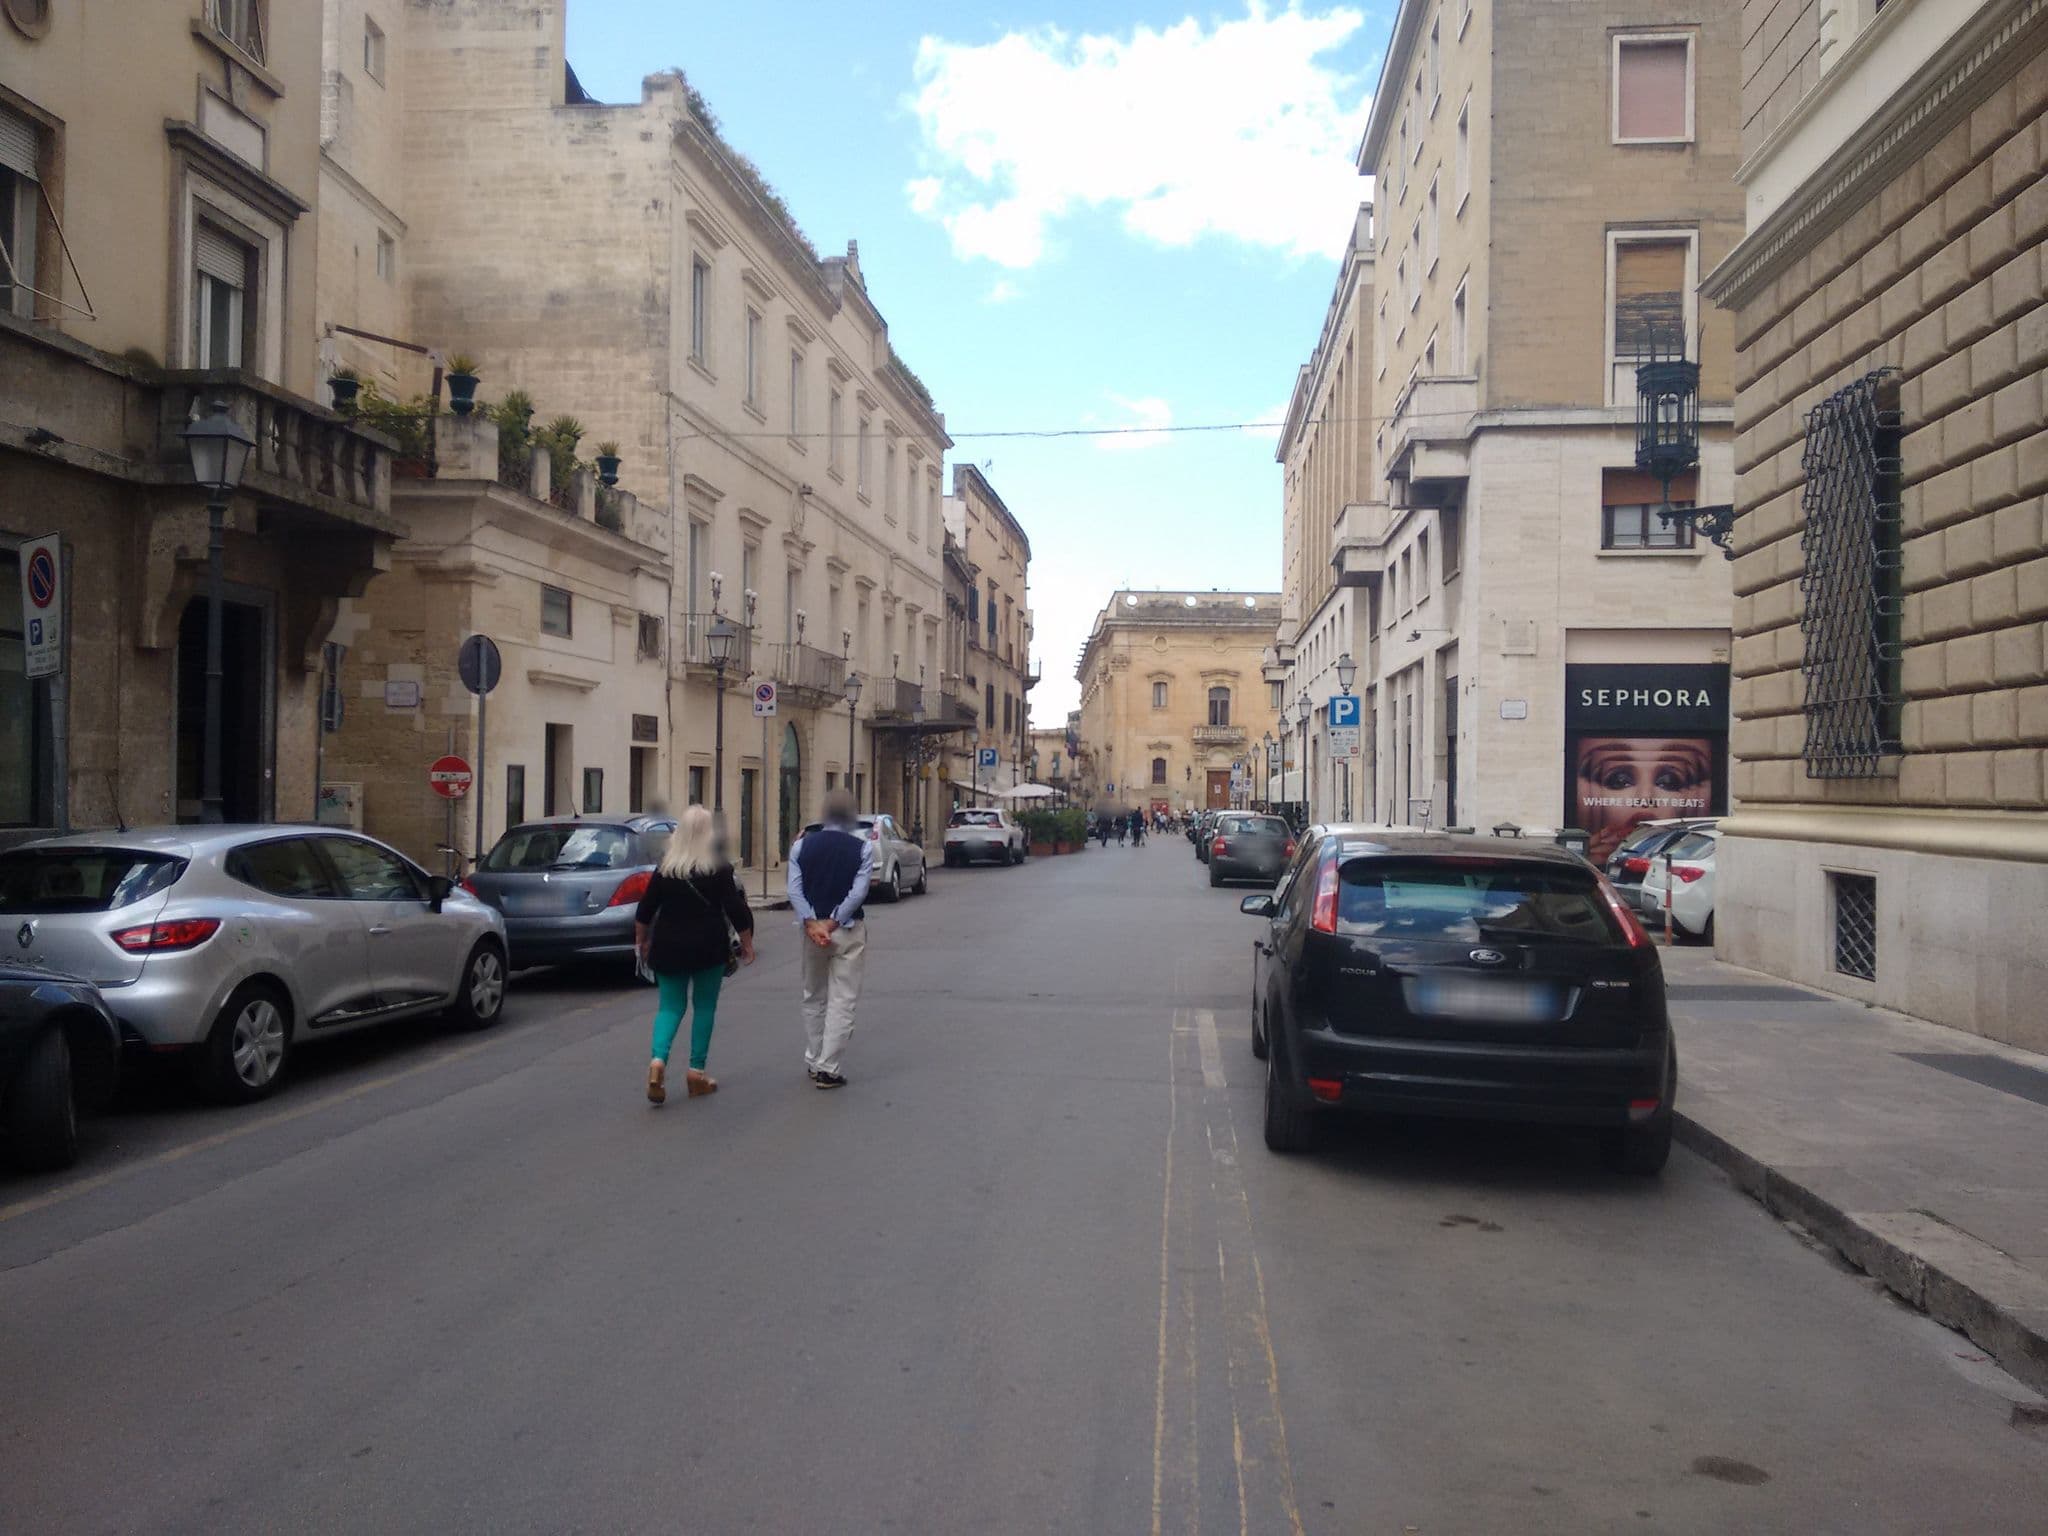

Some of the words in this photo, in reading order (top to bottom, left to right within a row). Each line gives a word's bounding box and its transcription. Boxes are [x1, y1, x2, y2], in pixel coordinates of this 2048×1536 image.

[31, 623, 39, 642] P
[1581, 689, 1711, 707] SEPHORA
[1335, 699, 1354, 724] P
[982, 750, 993, 764] P
[1583, 797, 1623, 808] WHERE
[1625, 797, 1669, 808] BEAUTY
[1671, 798, 1706, 809] BEATS
[1340, 967, 1377, 976] FOCUS
